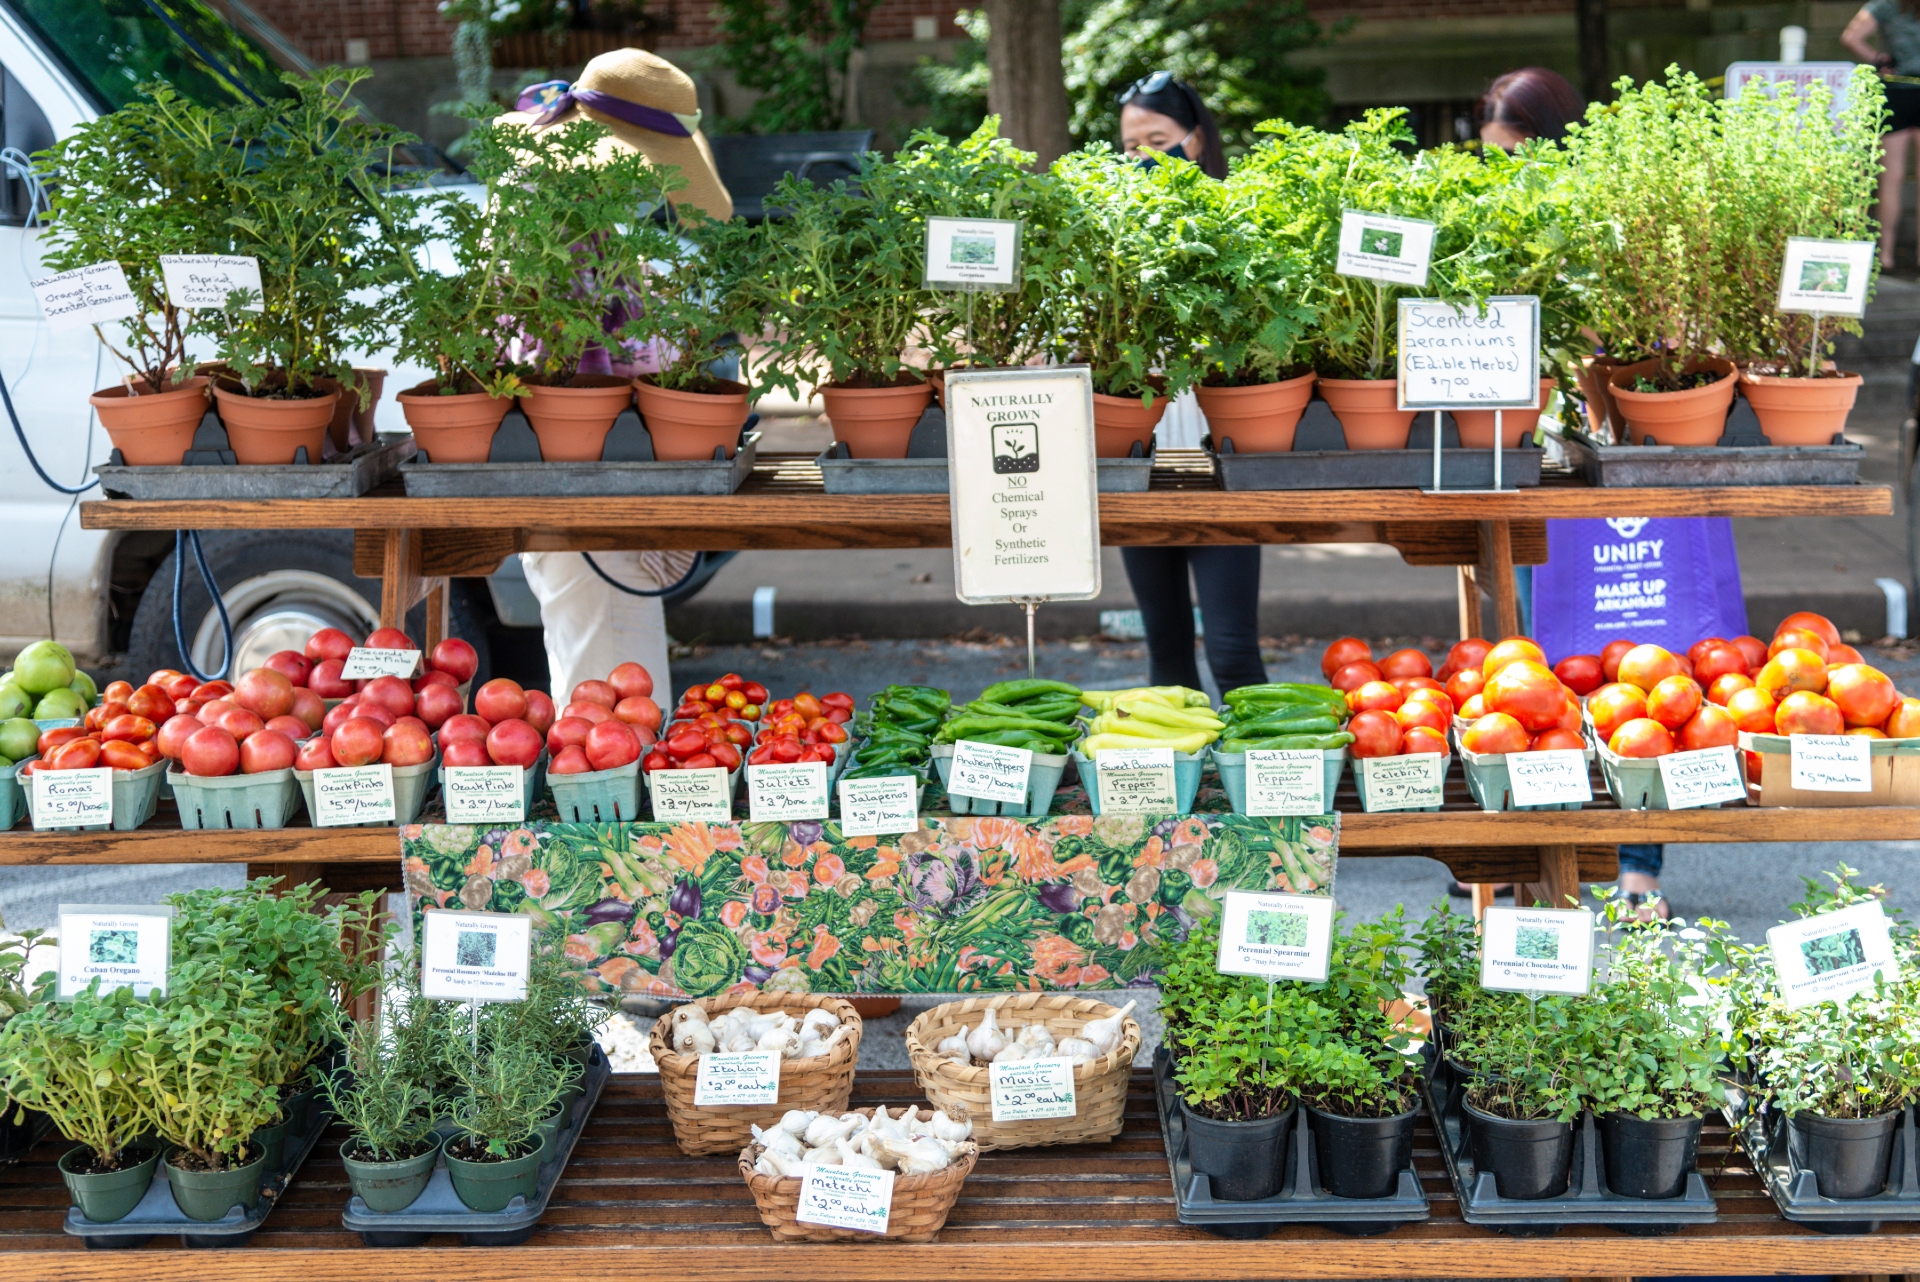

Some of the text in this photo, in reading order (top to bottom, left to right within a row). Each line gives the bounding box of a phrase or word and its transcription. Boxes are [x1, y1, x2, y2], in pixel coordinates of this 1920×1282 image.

[162, 256, 219, 268] Naturally
[1342, 251, 1417, 268] Citronella Scented Geranium
[45, 283, 112, 303] Orange Fizz
[45, 292, 133, 317] Scented Geranium
[1411, 306, 1505, 329] Scented
[1405, 351, 1519, 372] (Edible Herbs)
[1469, 386, 1500, 399] each
[971, 392, 1055, 408] NATURALLY
[986, 409, 1041, 422] GROWN
[1007, 476, 1027, 487] NO
[992, 490, 1044, 503] Chemical
[1000, 508, 1037, 520] Sprays
[1012, 523, 1027, 533] Or
[995, 539, 1046, 552] Synthetic
[1593, 539, 1664, 564] UNIFY
[994, 553, 1049, 565] Fertilizers
[1594, 579, 1667, 599] MASK UP
[1250, 752, 1321, 761] Sweet Italian
[956, 755, 993, 769] Anaheim
[994, 758, 1024, 776] Peppers
[1100, 759, 1172, 771] Sweet Banana
[1517, 764, 1573, 775] Celebrity
[1670, 762, 1726, 776] Celebrity
[355, 770, 380, 778] Greenery
[1257, 772, 1302, 786] Peppers
[1372, 767, 1429, 779] Celebrity
[48, 784, 93, 794] Romas
[320, 781, 384, 792] Ozark Pinks
[451, 781, 514, 791] Ozark Pinks
[755, 777, 810, 789] Juliets
[1112, 780, 1156, 791] Peppers
[848, 791, 908, 804] Jalapenos
[47, 801, 102, 814] $5.00/box
[329, 799, 379, 812] $5.00/box
[1257, 900, 1283, 909] Naturally
[455, 921, 479, 929] Naturally
[1516, 916, 1543, 925] Naturally
[1802, 926, 1828, 938] Naturally
[1238, 945, 1310, 958] Perennial Spearmint
[109, 967, 140, 975] Oregano
[1492, 959, 1578, 971] Perennial Chocolate Mint
[1791, 979, 1818, 990] Perennial
[1818, 970, 1849, 983] Peppermint
[709, 1065, 766, 1073] Italian
[1034, 1062, 1060, 1070] Greenery
[708, 1079, 764, 1091] $2.00 each
[999, 1075, 1050, 1085] Music
[1004, 1091, 1066, 1106] $2.00 each
[816, 1166, 881, 1181] Mountain Greenery
[825, 1175, 852, 1183] naturally
[812, 1178, 871, 1193] Metechi
[812, 1195, 873, 1216] $2.00 each
